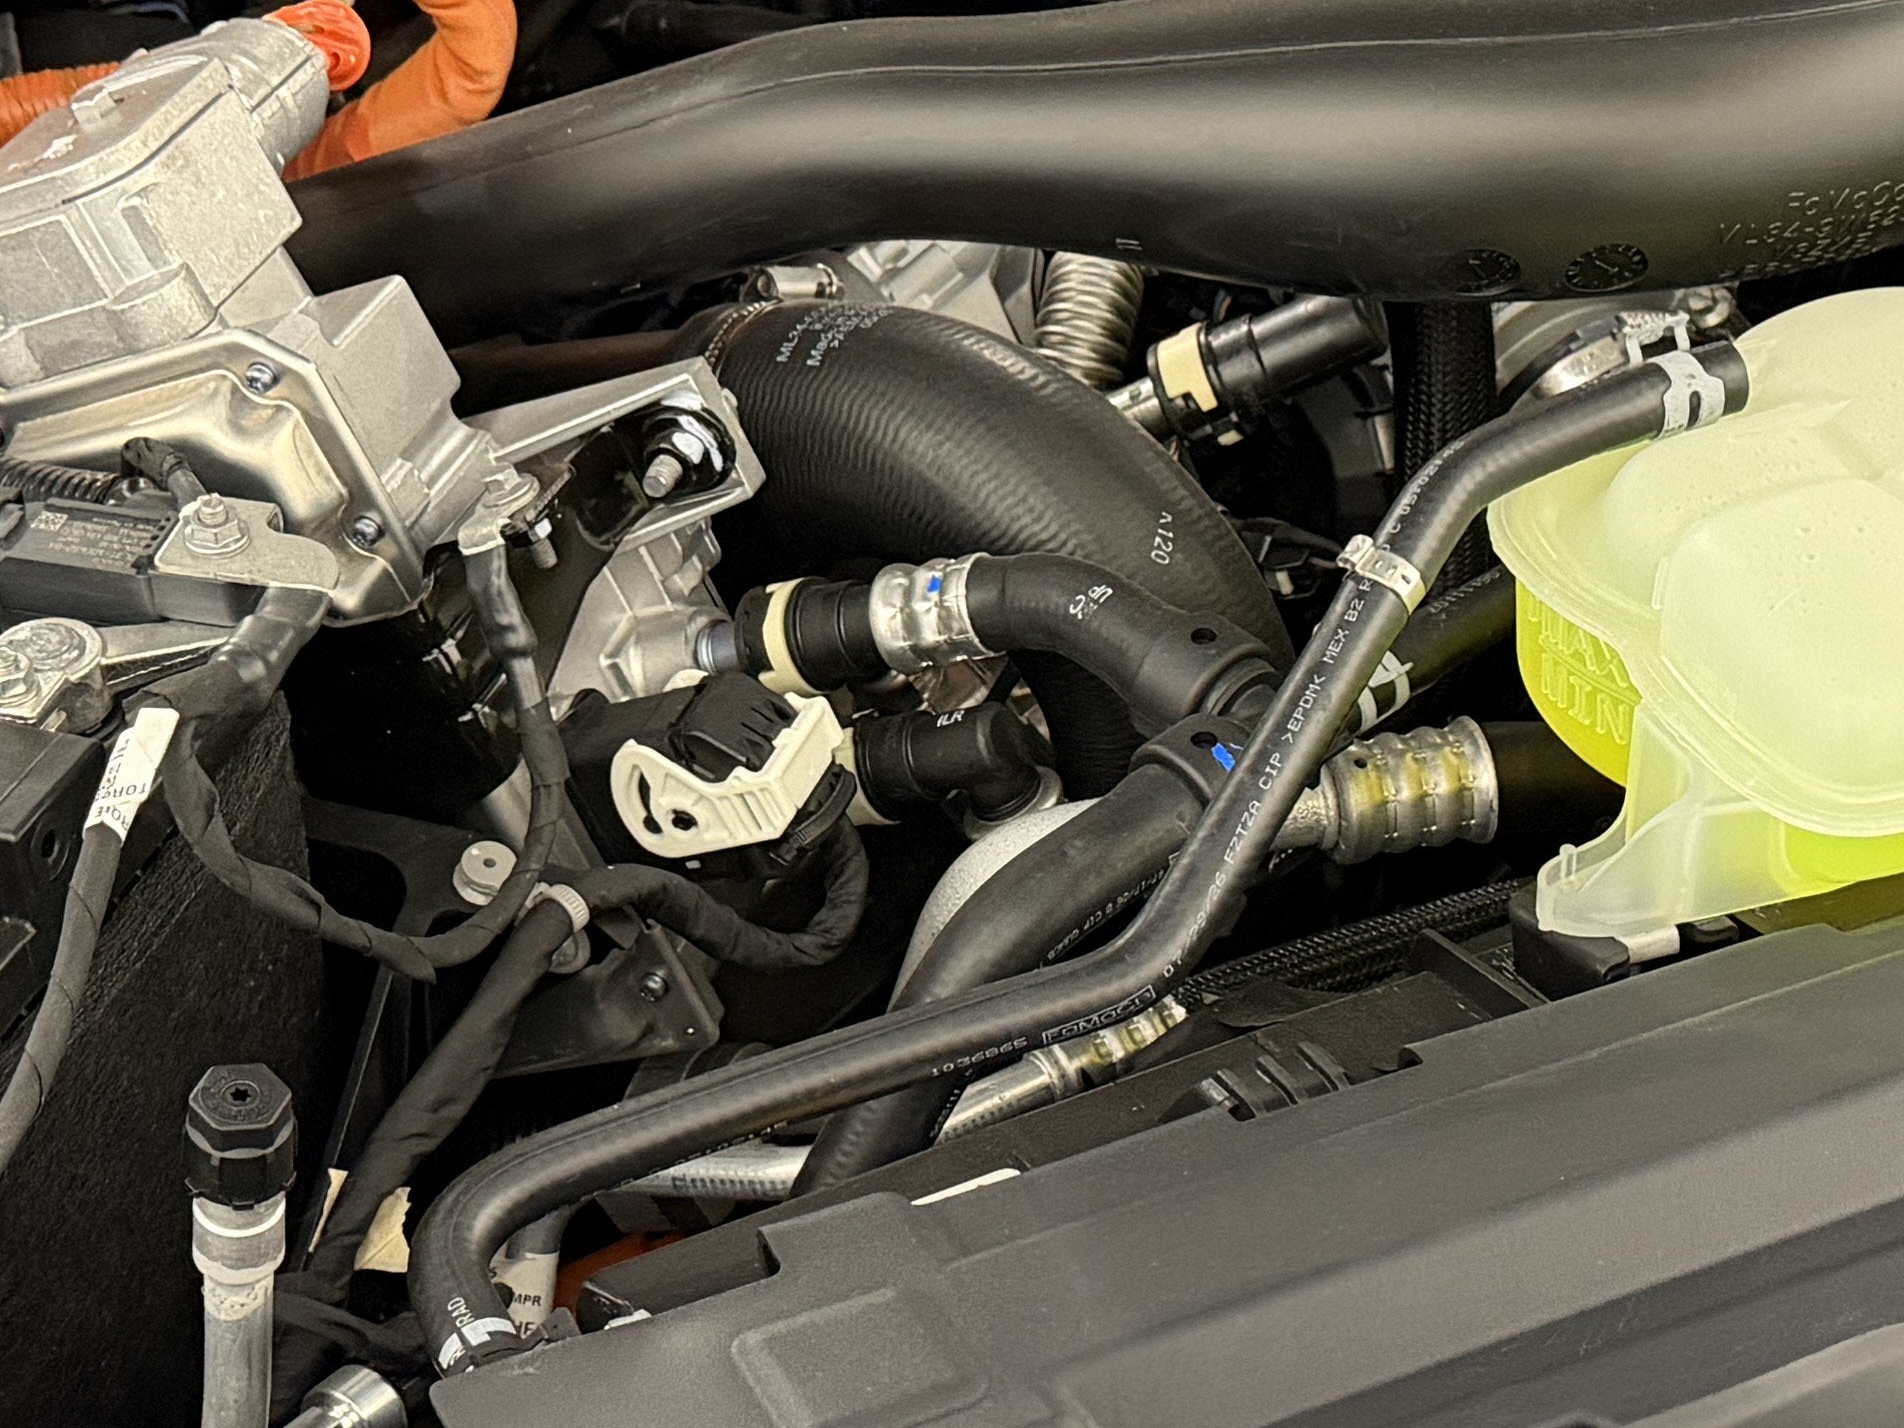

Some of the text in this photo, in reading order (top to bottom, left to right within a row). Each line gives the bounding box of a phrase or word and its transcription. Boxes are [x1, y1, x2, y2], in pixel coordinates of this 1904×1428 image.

[1254, 749, 1286, 791] CIP
[1321, 625, 1351, 666] MEX
[1540, 652, 1630, 746] MIN
[447, 1296, 476, 1328] RAD
